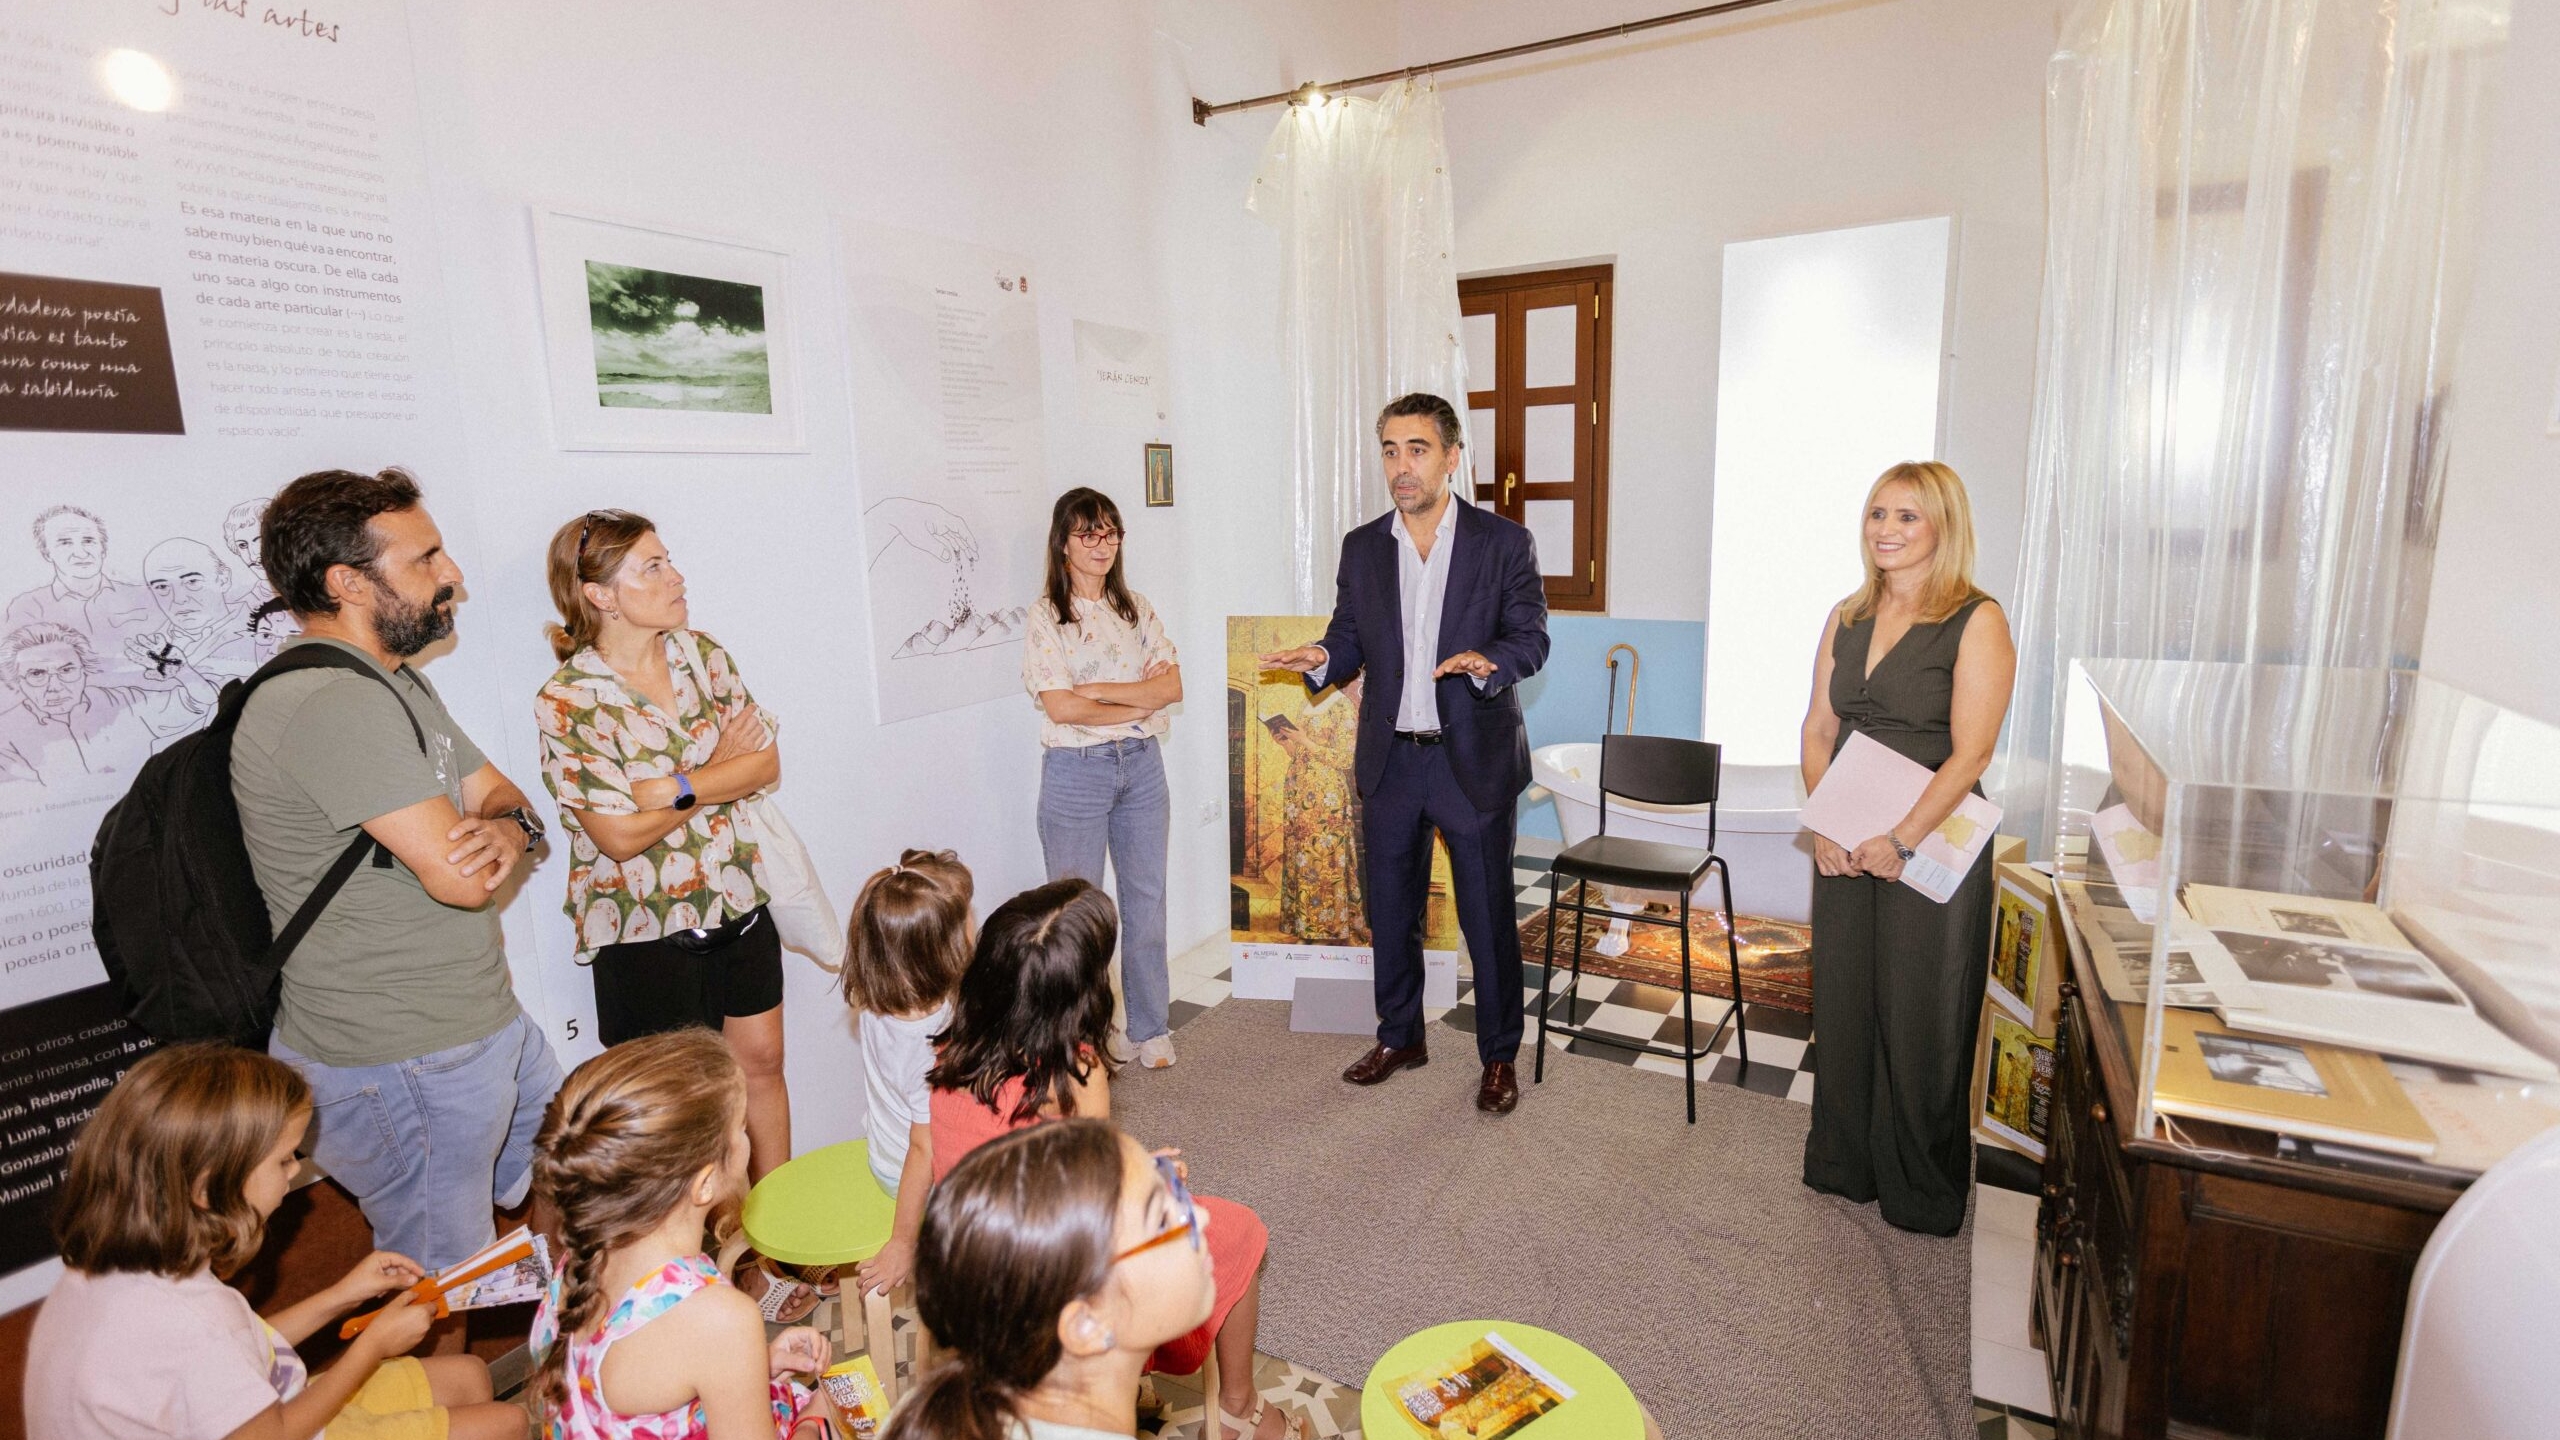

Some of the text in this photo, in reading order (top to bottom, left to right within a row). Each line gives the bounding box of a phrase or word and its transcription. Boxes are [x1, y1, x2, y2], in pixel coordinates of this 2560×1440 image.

[264, 8, 340, 43] artes
[61, 112, 121, 134] invisible
[125, 127, 135, 137] o
[15, 130, 32, 143] es
[36, 134, 90, 153] poema
[94, 144, 139, 160] visible
[180, 201, 393, 244] Es esa materia en la que uno no
[184, 226, 397, 265] sabe muy bien qué va a encontrar,
[188, 250, 398, 284] esa materia oscura. De ella cada
[193, 271, 402, 304] uno saca algo con instrumentos
[82, 307, 142, 330] poesía
[196, 292, 214, 305] de
[218, 295, 250, 309] cada
[254, 300, 281, 311] arte
[284, 301, 343, 318] particular
[384, 314, 404, 324] que
[48, 332, 66, 345] es
[73, 329, 129, 350] tanto
[218, 318, 278, 332] comienza
[282, 324, 301, 335] por
[305, 326, 332, 337] crear
[337, 329, 350, 338] es
[353, 329, 362, 340] la
[203, 338, 258, 352] principio
[263, 341, 313, 356] absoluto
[318, 347, 332, 357] de
[337, 348, 361, 360] toda
[41, 358, 92, 371] como
[100, 363, 143, 375] una
[223, 360, 234, 372] la
[271, 366, 279, 376] y
[294, 367, 338, 381] primero
[340, 370, 362, 380] que
[364, 369, 390, 381] tiene
[393, 373, 412, 382] que
[21, 376, 119, 399] sabiduría
[210, 382, 416, 402] hacer todo artista es tener el estado
[214, 403, 417, 420] de disponibilidad que presupone un
[218, 426, 264, 437] espacio
[3, 850, 87, 879] oscuridad
[47, 880, 67, 893] de
[68, 876, 81, 889] la
[5, 911, 26, 926] en
[32, 930, 44, 942] o
[4, 945, 77, 974] poesía o
[566, 1018, 579, 1040] 5
[2, 1018, 129, 1064] con otros creado
[37, 1056, 93, 1081] intensa,
[94, 1047, 122, 1063] con
[123, 1040, 138, 1054] la
[30, 1075, 115, 1111] Rebeyrolle,
[7, 1123, 52, 1146] Luna,
[0, 1144, 66, 1175] Gonzalo
